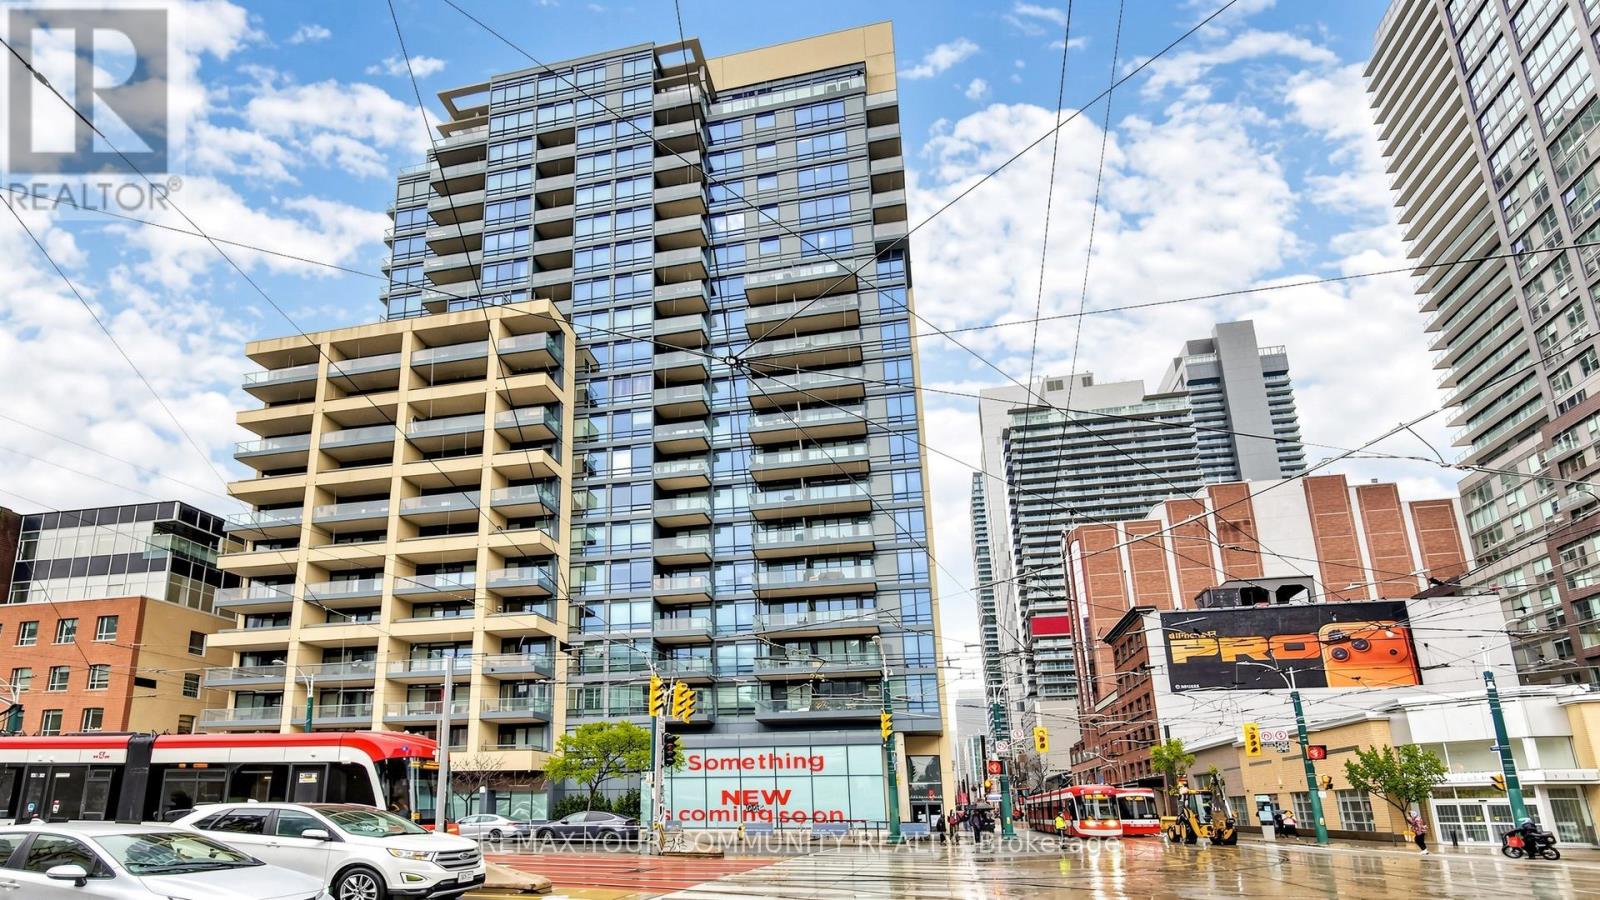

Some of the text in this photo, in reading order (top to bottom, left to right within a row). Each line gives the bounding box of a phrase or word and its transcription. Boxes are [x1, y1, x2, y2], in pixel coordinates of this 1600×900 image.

[1170, 635, 1320, 663] PRO
[688, 753, 824, 771] Something
[721, 789, 791, 805] NEW
[679, 806, 773, 823] coming
[779, 809, 844, 823] soon
